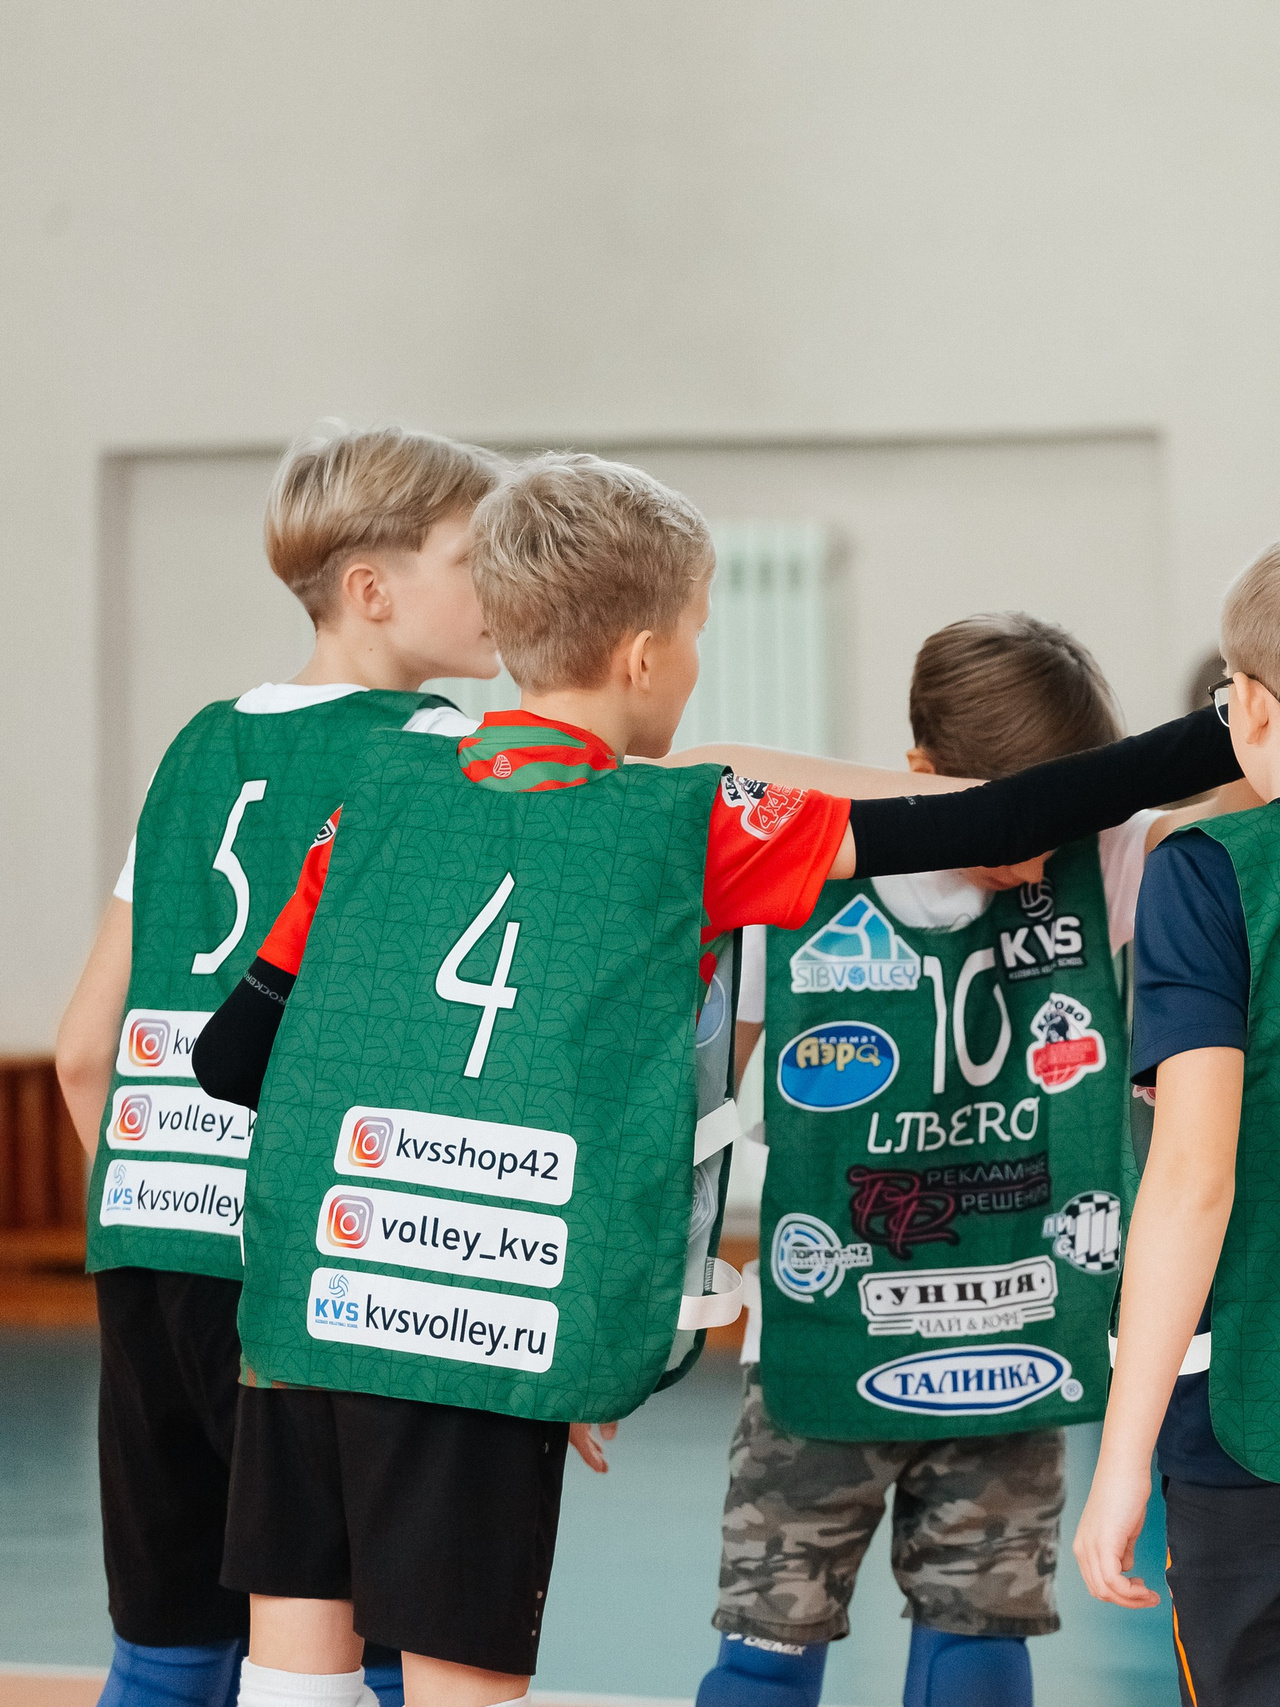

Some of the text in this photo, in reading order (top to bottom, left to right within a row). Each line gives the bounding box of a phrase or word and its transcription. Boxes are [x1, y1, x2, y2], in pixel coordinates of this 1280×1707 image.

[192, 780, 267, 974] 5
[1000, 916, 1082, 968] KVS
[244, 970, 288, 1005] ROCKBR
[436, 872, 520, 1078] 4
[923, 947, 1012, 1094] 10
[156, 1103, 258, 1142] volley_k
[867, 1096, 1041, 1154] LIBERO
[396, 1129, 560, 1181] kvsshop42
[926, 1158, 1046, 1186] РЕКЛАМ
[137, 1180, 246, 1226] kvsvolley
[961, 1182, 1048, 1213] РЕШЕ
[382, 1214, 559, 1266] volley_kvs
[315, 1297, 359, 1322] KVS
[889, 1273, 1036, 1306] УНЦИЯ
[365, 1294, 547, 1356] kvsvolley.ru
[894, 1362, 1042, 1396] ТАЛИНКА
